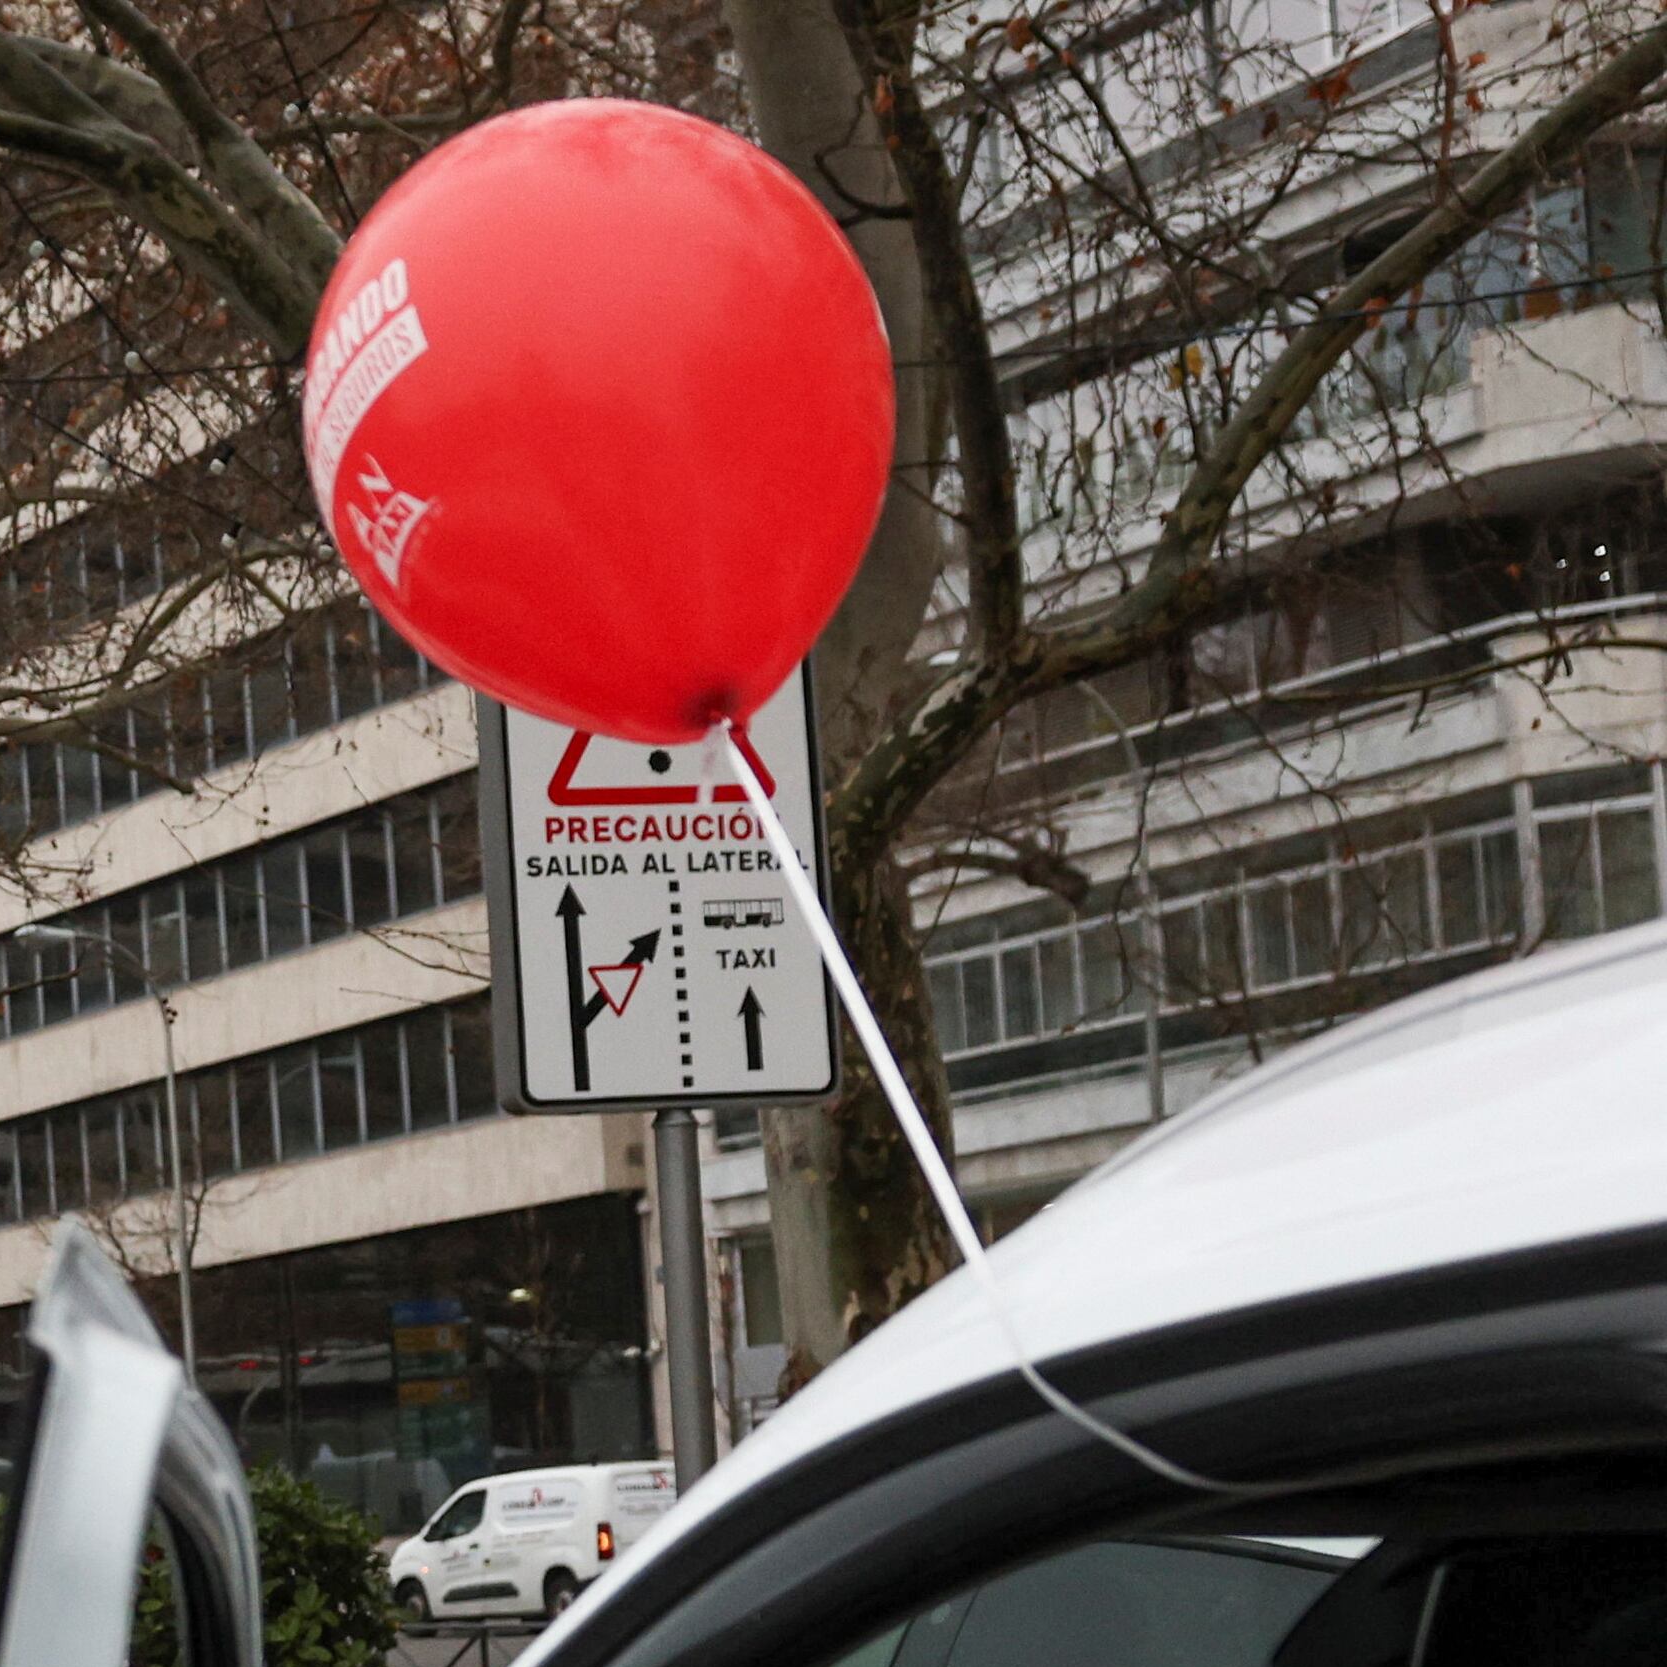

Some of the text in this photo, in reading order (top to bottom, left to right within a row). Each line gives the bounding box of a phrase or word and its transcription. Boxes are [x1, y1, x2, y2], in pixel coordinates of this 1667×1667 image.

[526, 852, 629, 878] SALIDA
[642, 851, 676, 873] AL
[715, 947, 777, 970] TAXI
